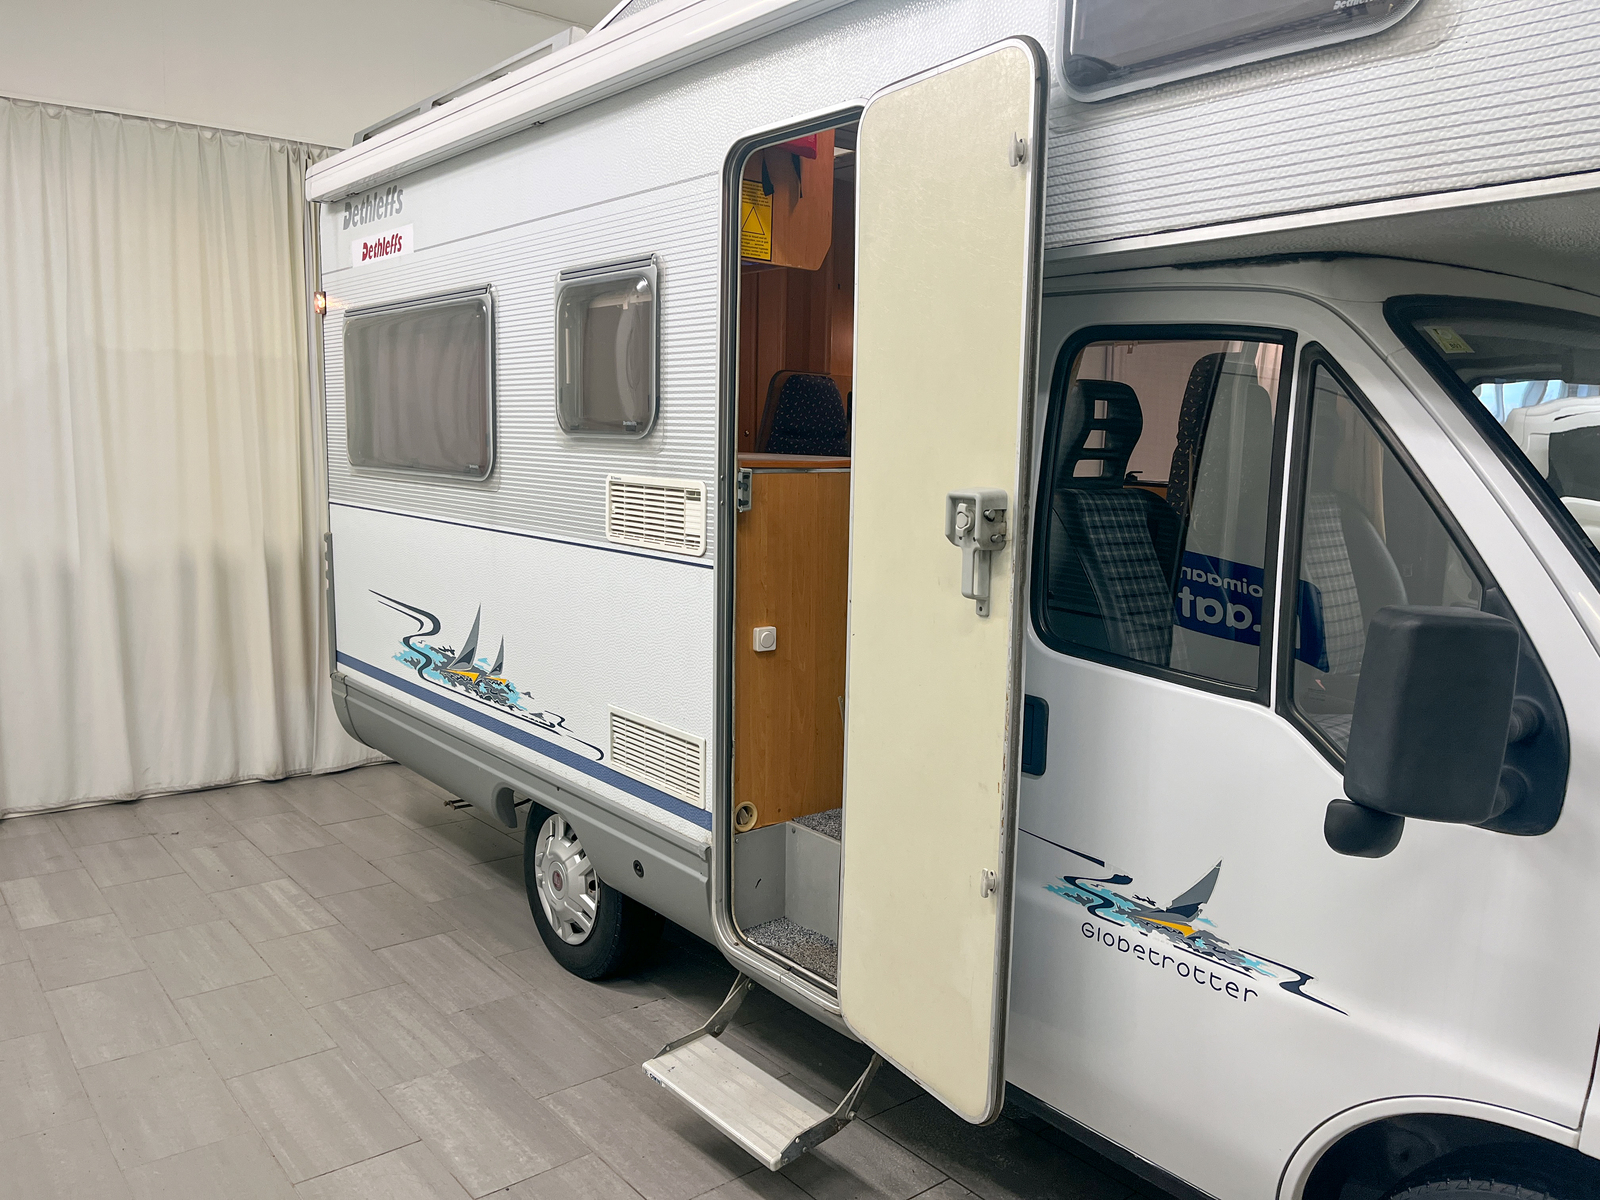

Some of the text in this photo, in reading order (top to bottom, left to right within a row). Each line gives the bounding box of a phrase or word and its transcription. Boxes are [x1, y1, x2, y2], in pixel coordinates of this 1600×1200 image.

[343, 185, 404, 230] Dethleffs
[362, 233, 403, 261] Dethleffs
[1081, 922, 1259, 1002] Globetrotter
